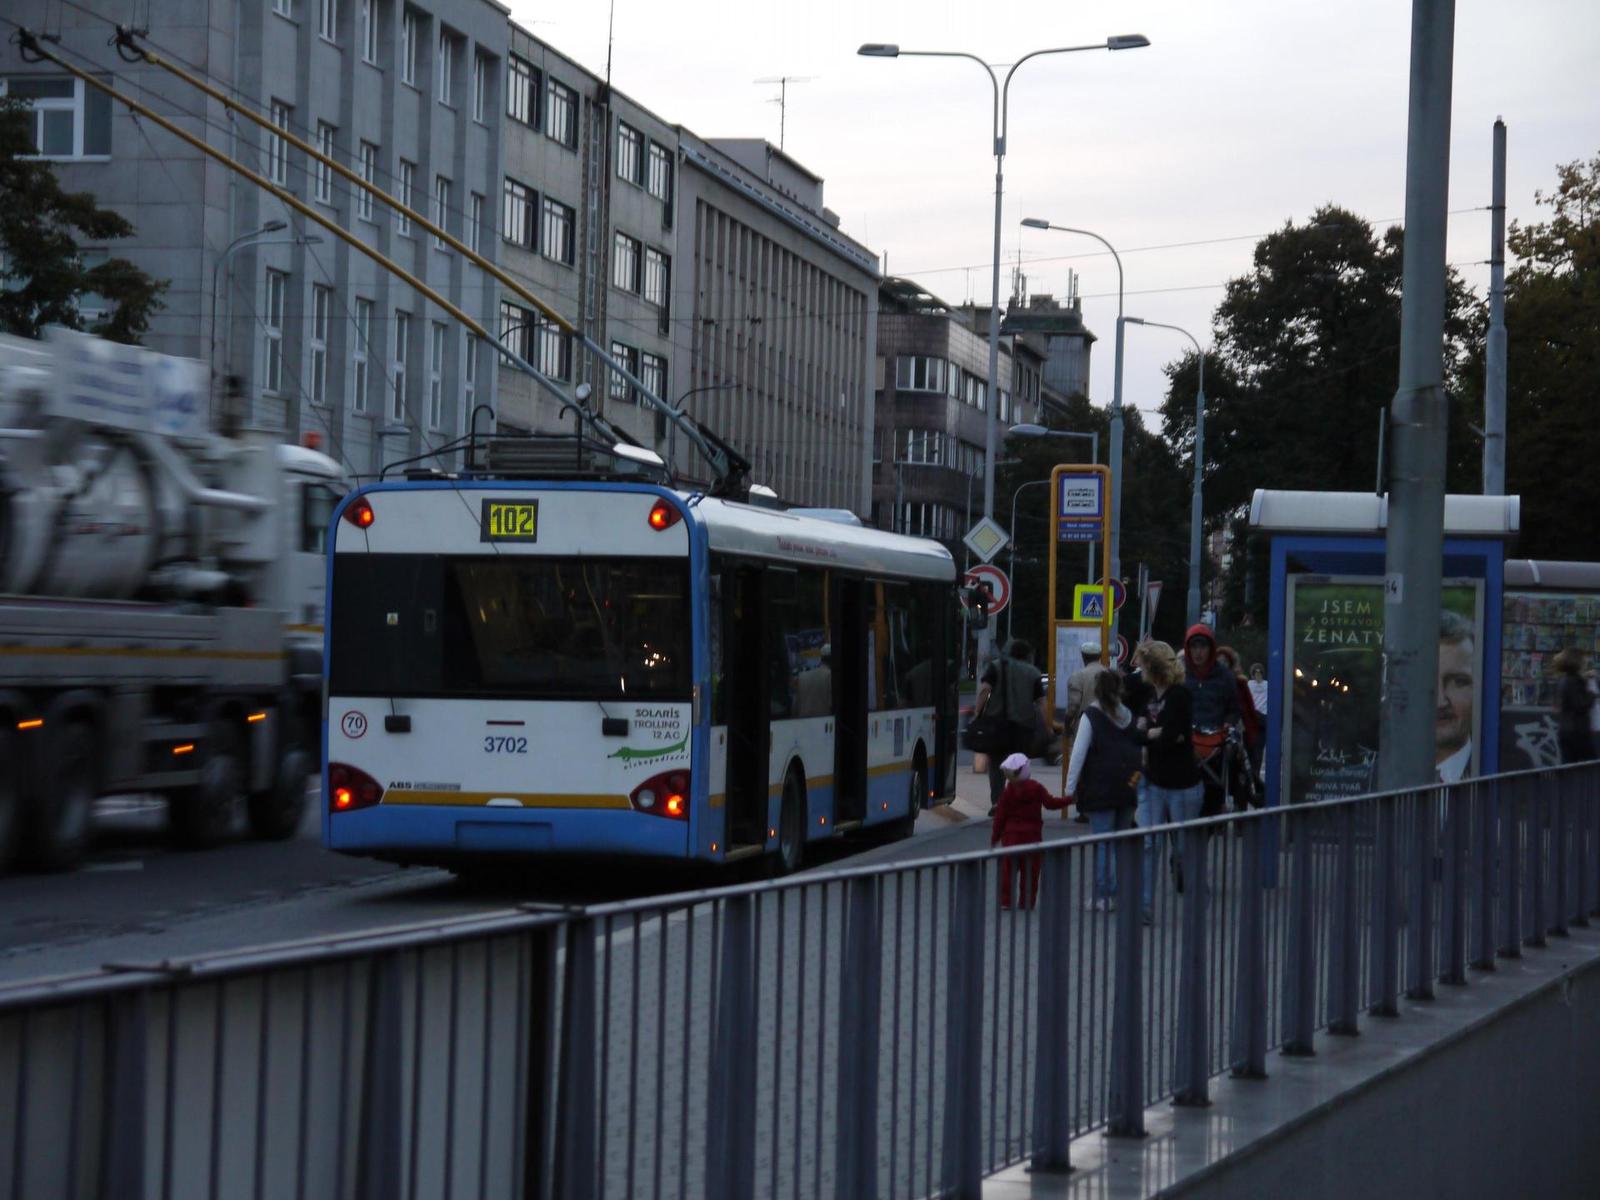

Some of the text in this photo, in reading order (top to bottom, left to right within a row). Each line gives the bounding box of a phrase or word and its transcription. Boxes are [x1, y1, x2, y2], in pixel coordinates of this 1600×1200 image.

[492, 508, 532, 533] 102
[1320, 599, 1371, 614] JSEM
[635, 707, 679, 718] SOLARIS
[347, 716, 363, 729] 70
[634, 720, 680, 729] TROLLINO
[653, 731, 680, 740] 12 AC
[484, 736, 527, 753] 3702
[389, 781, 412, 789] ABS
